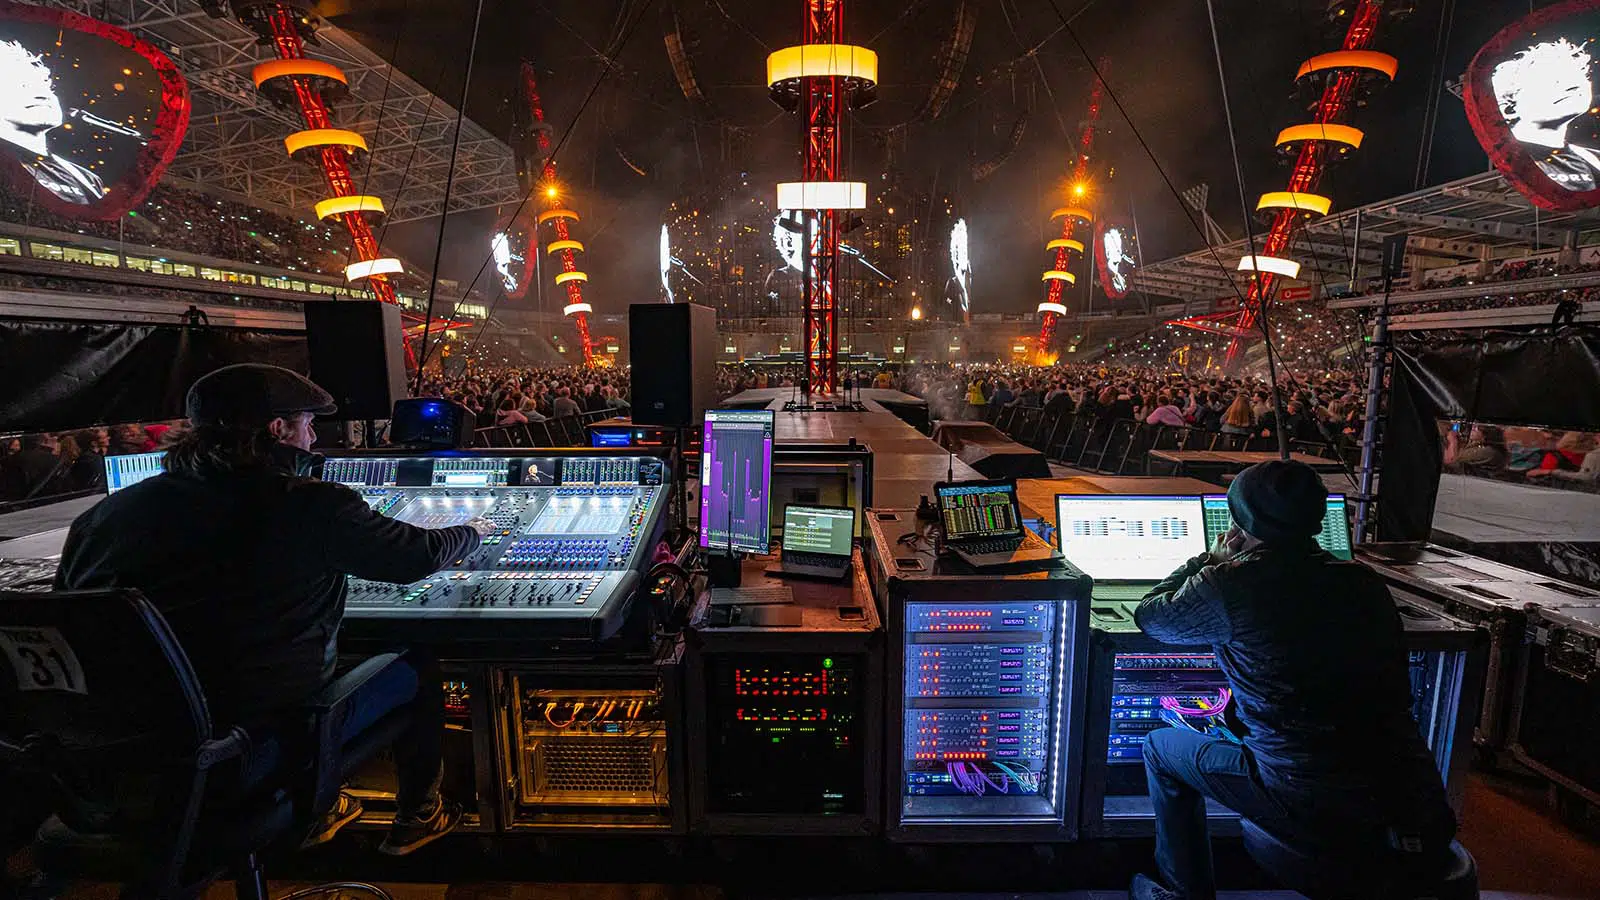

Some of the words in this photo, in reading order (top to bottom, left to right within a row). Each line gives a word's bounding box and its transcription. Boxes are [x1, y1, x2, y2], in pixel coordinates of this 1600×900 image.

[1547, 173, 1593, 182] CORK
[38, 179, 84, 196] CORK
[18, 647, 74, 688] 31
